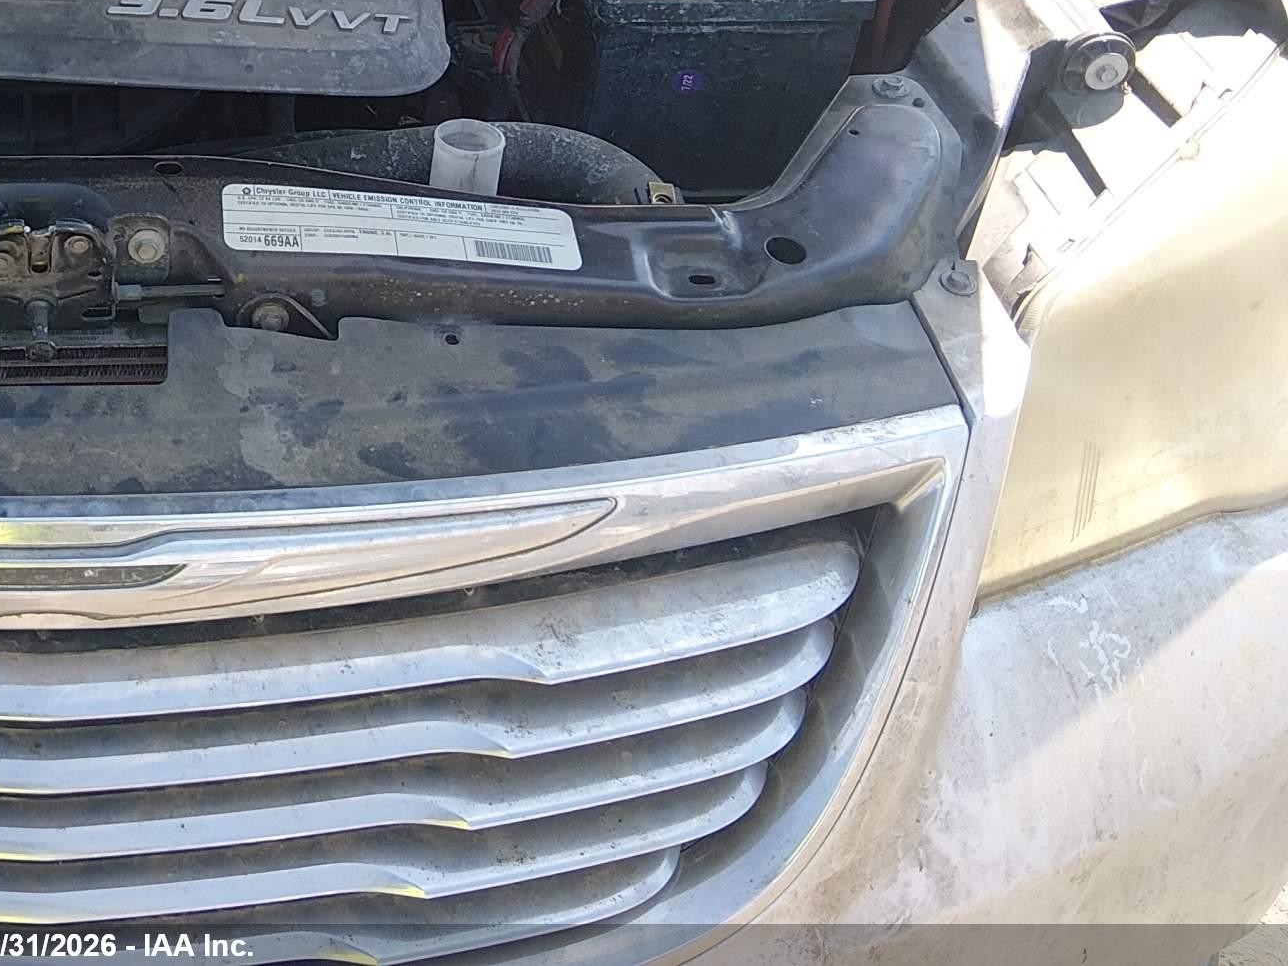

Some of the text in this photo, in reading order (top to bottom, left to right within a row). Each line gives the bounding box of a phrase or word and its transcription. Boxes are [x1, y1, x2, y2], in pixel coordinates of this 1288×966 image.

[256, 187, 286, 196] Chrysler
[288, 189, 310, 198] Group
[331, 192, 361, 201] VEHICLE
[363, 194, 397, 204] EMISSION
[399, 198, 432, 207] CONTROL
[434, 200, 483, 211] INFORMATION
[264, 234, 300, 248] 669AA
